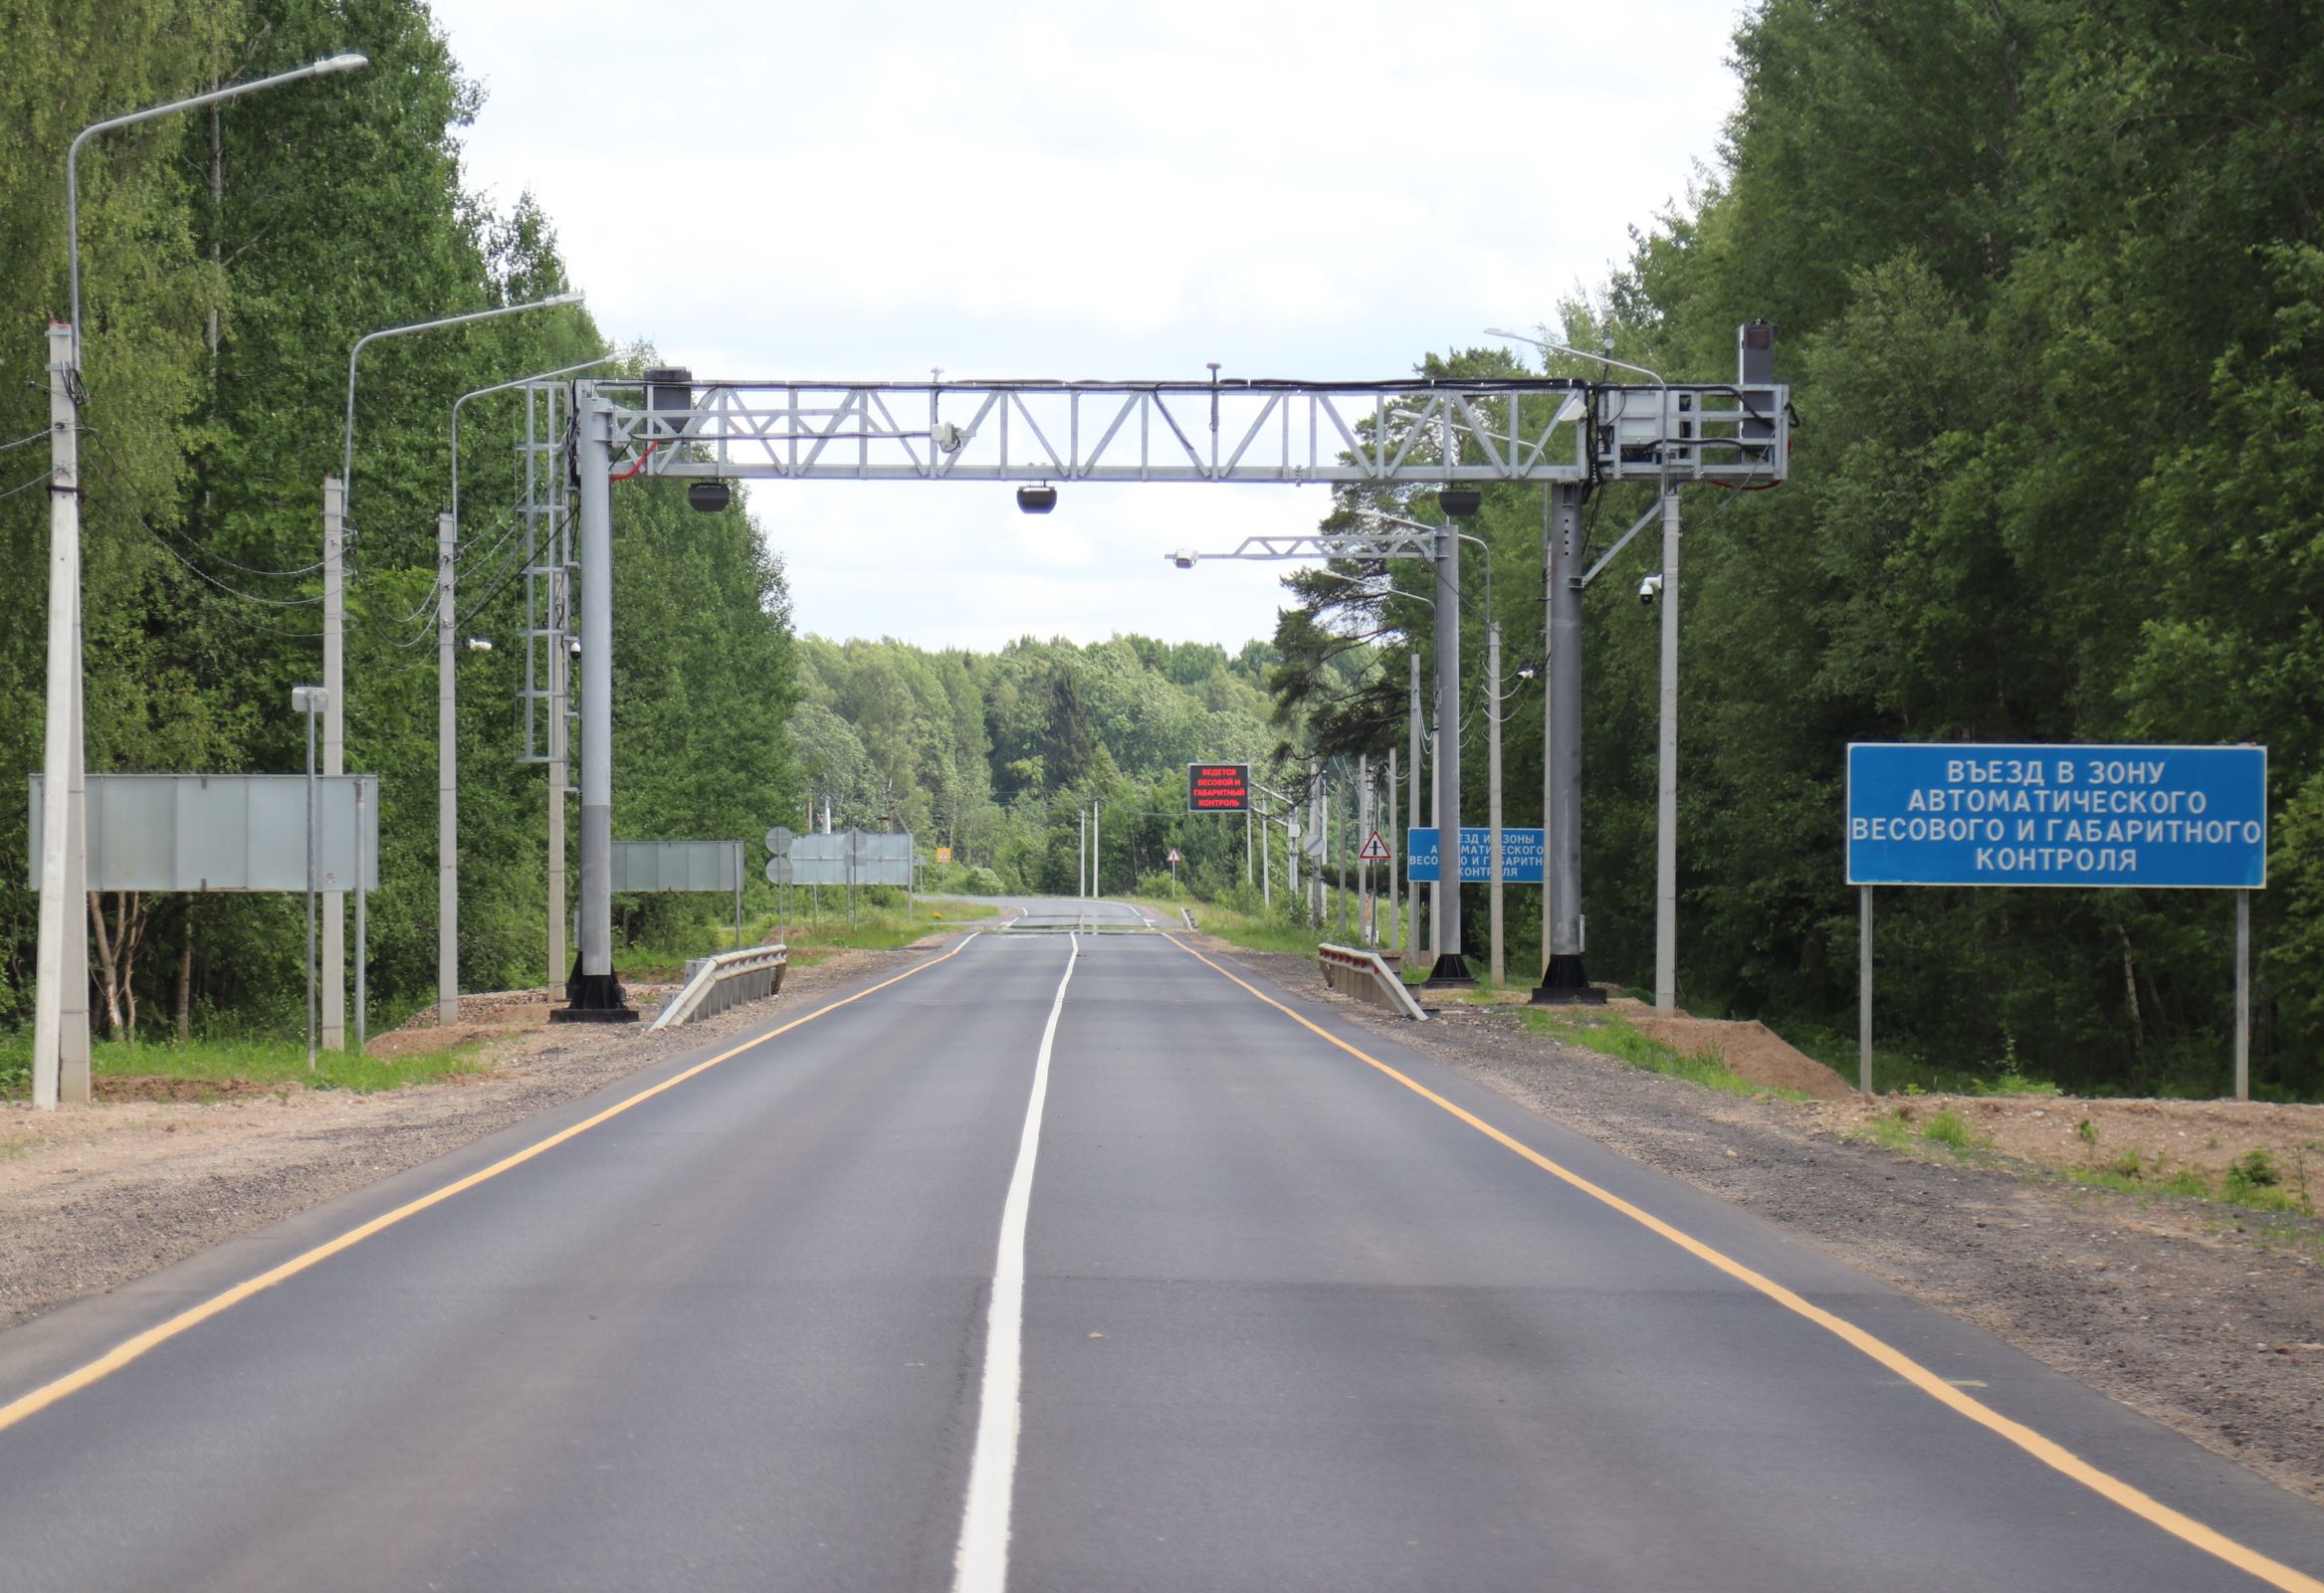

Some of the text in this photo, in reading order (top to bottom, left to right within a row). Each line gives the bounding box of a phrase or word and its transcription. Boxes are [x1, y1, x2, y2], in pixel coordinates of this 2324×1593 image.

[1948, 760, 2166, 786] ВЪЕЗД В ЗОНУ
[1197, 777, 1233, 786] ВЕСОВОЙ
[1907, 789, 2207, 814] АВТОМАТИЧЕСКОГО
[1852, 818, 2262, 844] ВЕСОВОГО И ГАБАРИТНОГО
[1503, 834, 1535, 844] ЗОНЫ
[1430, 845, 1544, 856] АМАТИЕСКОГО
[1409, 855, 1468, 866] ВЕСОО
[1472, 857, 1479, 866] И
[1976, 848, 2137, 872] КОНТРОЛЯ
[1457, 867, 1518, 877] КОНТРЛЯ
